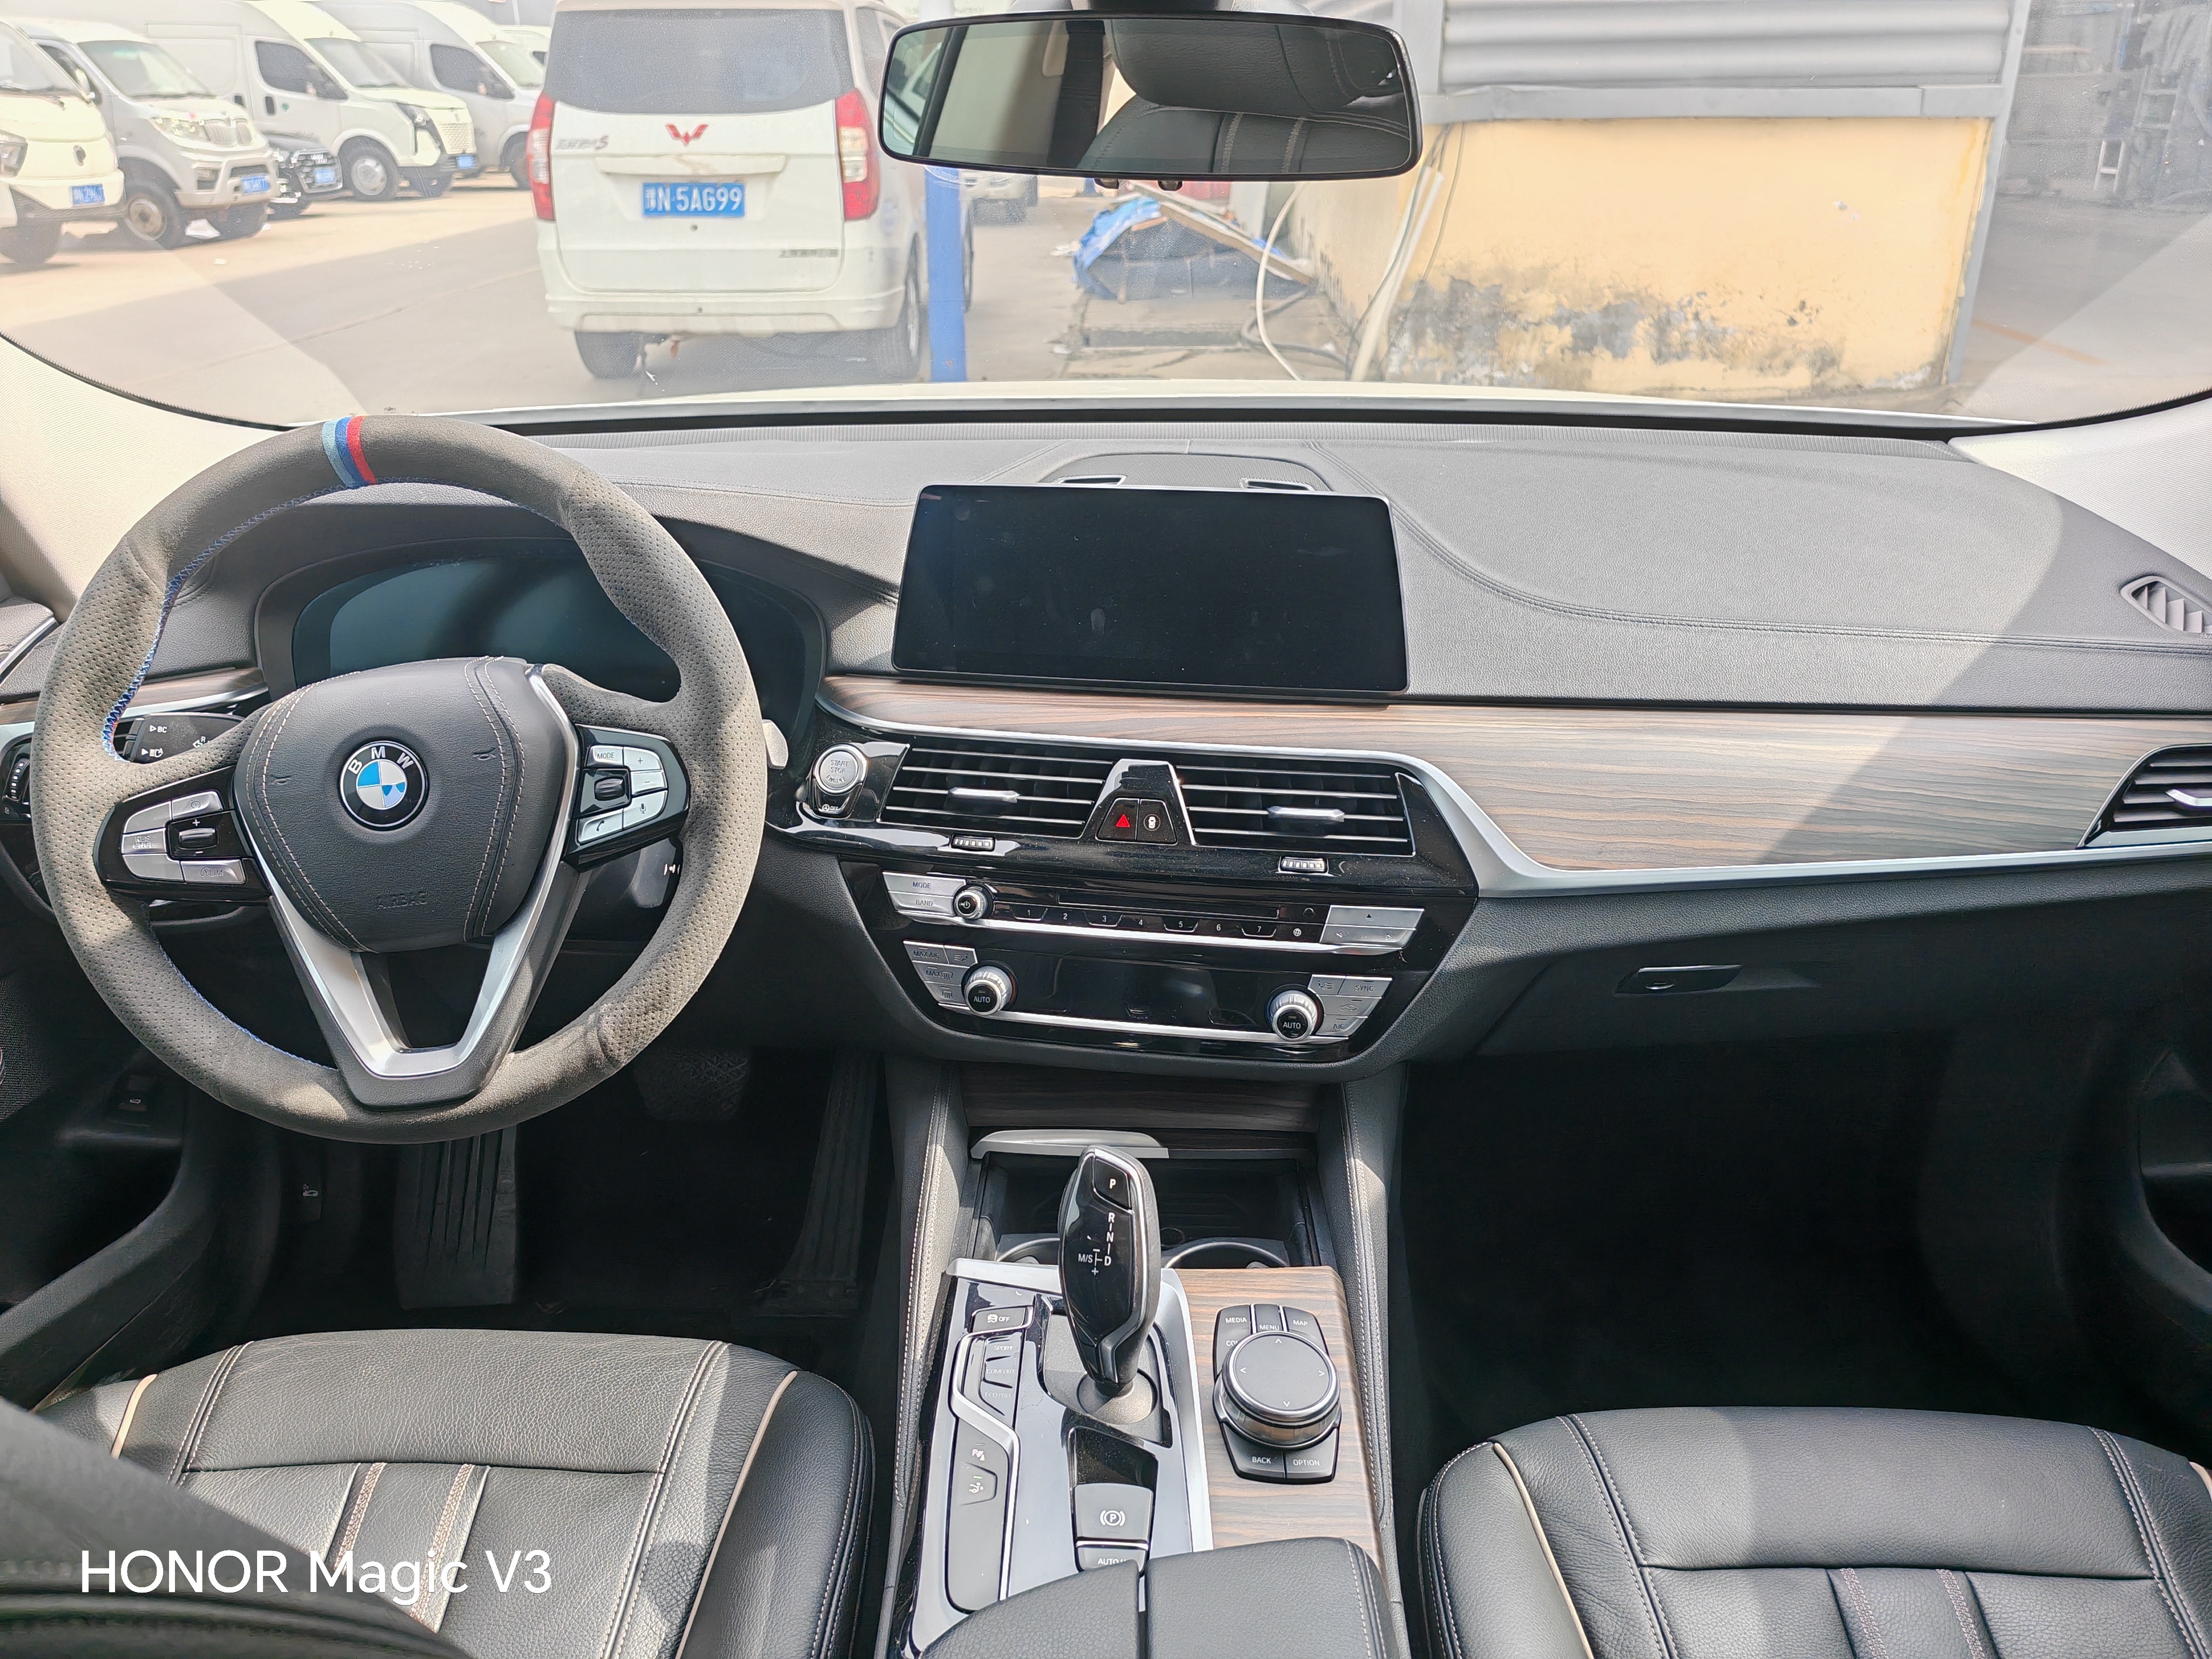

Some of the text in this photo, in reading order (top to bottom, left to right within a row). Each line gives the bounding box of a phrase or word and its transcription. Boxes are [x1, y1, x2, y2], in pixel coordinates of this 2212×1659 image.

[348, 746, 414, 774] BMW
[825, 774, 847, 784] ENGINE
[926, 970, 941, 978] MAX
[1354, 984, 1374, 993] SYNC
[1110, 1178, 1116, 1189] P
[1108, 1212, 1115, 1223] R
[1107, 1231, 1114, 1242] N
[1078, 1253, 1093, 1263] M/S
[1104, 1256, 1111, 1266] D
[1252, 1456, 1271, 1465] BACK
